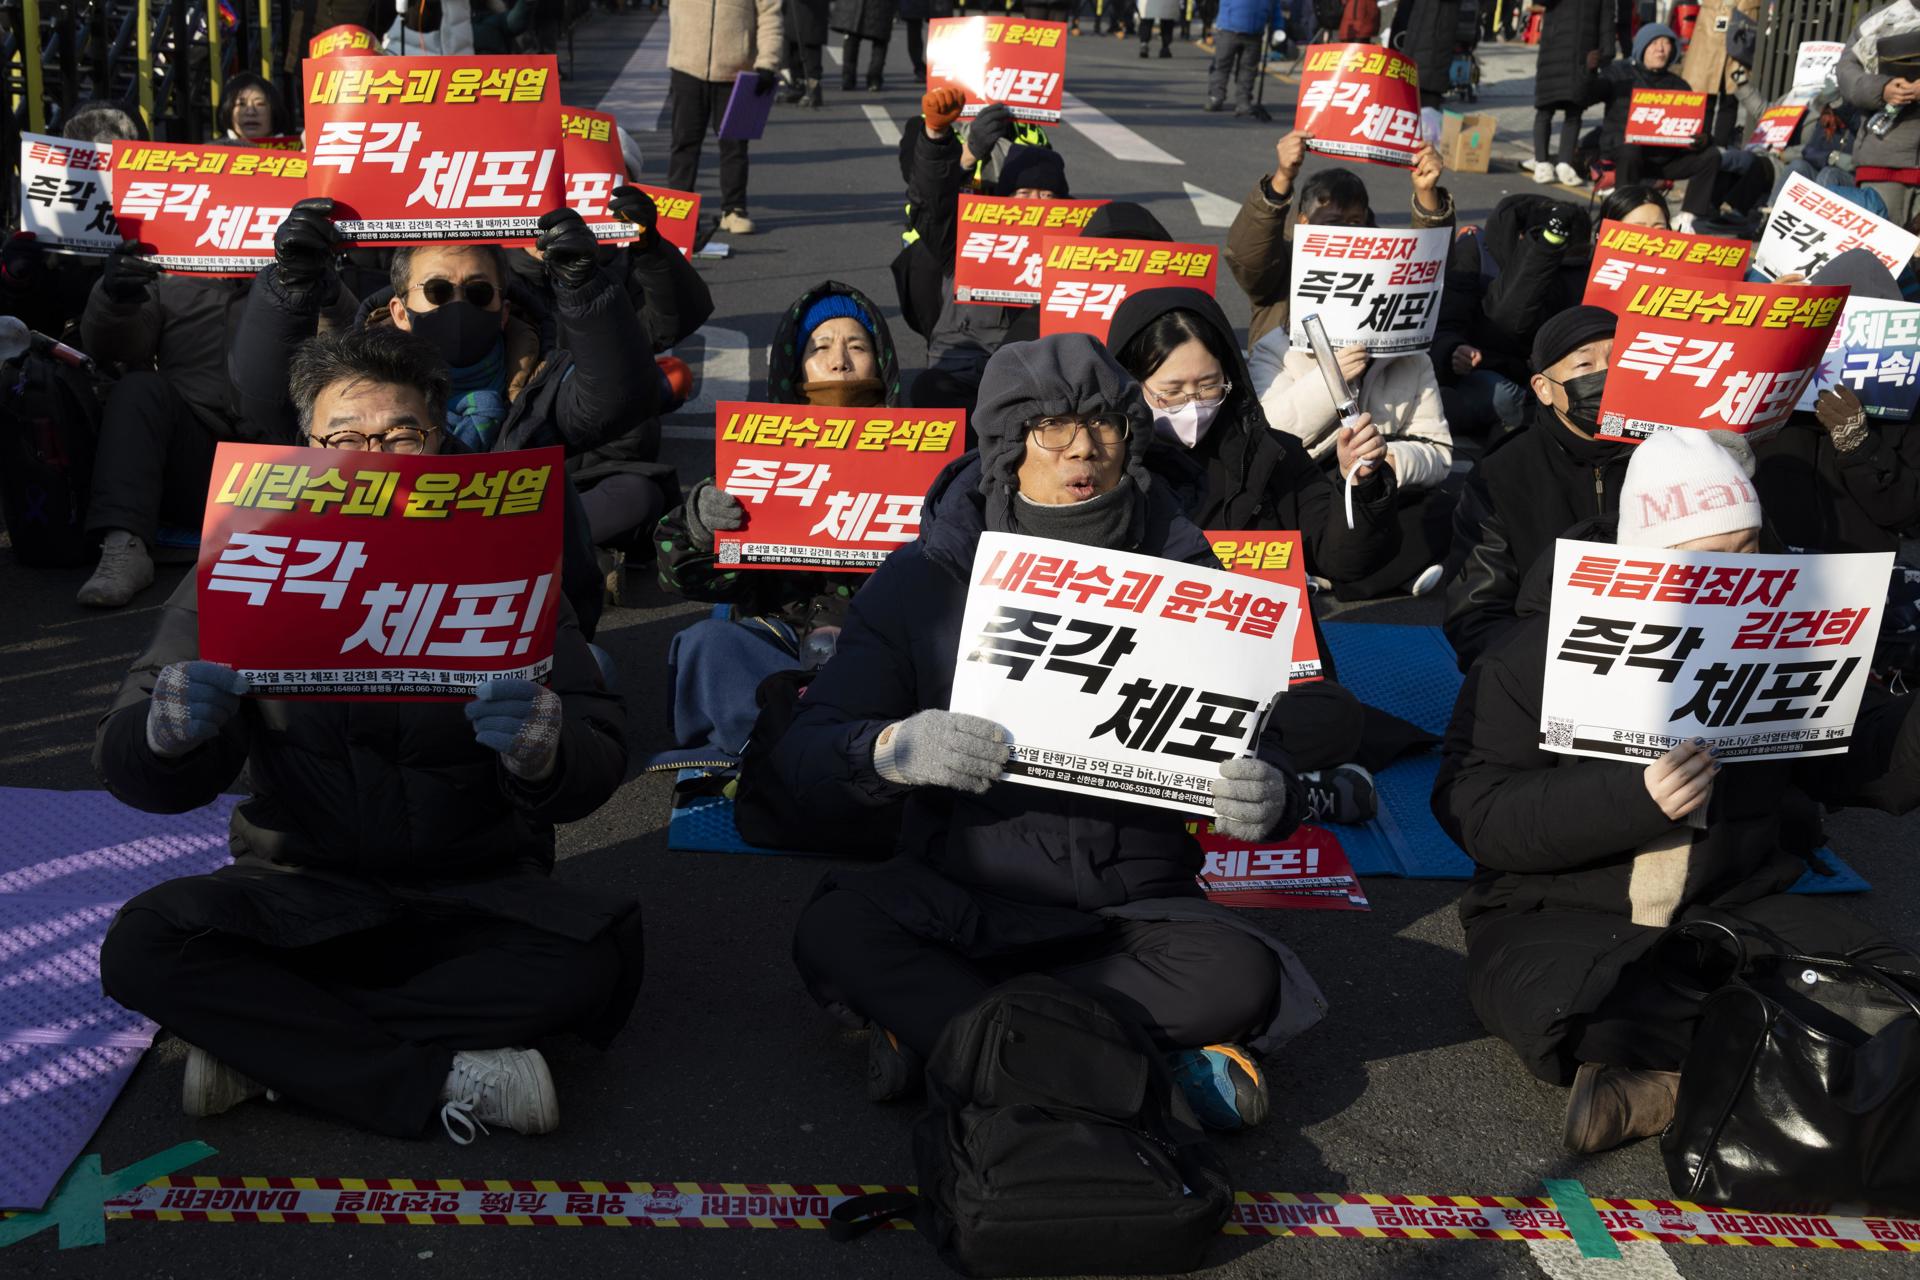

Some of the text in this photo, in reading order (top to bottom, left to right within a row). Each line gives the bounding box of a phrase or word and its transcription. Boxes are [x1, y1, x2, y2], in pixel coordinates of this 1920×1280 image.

[312, 32, 370, 59] 내란수괴
[1004, 24, 1061, 47] 윤석열
[1306, 50, 1387, 75] 내란수괴
[309, 68, 548, 104] 내란수괴 윤석열
[1301, 80, 1371, 115] 즉각
[1631, 107, 1665, 125] 즉각
[1655, 117, 1701, 136] 체포!
[117, 149, 308, 178] 내란수괴 윤석열
[312, 122, 422, 174] 즉각
[27, 175, 97, 212] 즉각
[405, 149, 557, 209] 체포!
[565, 173, 623, 216] 포!
[120, 182, 211, 222] 즉각
[647, 193, 694, 220] 석열
[961, 202, 1045, 226] 내란수괴
[1786, 182, 1879, 238] 특급범죄자
[340, 221, 364, 231] 윤석열
[367, 222, 383, 230] 즉각
[386, 221, 406, 230] 체포!
[408, 220, 432, 230] 김건희
[454, 219, 472, 229] 구속!
[1770, 210, 1828, 253] 즉각
[960, 232, 1030, 266] 즉각
[1046, 245, 1212, 278] 내란수괴 윤석열
[1302, 234, 1418, 260] 특급범죄자
[1601, 229, 1746, 268] 내란수괴 윤석열
[1835, 236, 1900, 270] 김희
[1297, 270, 1374, 306] 즉각
[1388, 260, 1442, 286] 김건희
[1593, 258, 1667, 291] 즉
[1045, 281, 1128, 321] 즉각
[1357, 290, 1438, 332] 체포!
[1626, 284, 1843, 329] 내란수괴 윤석열
[1846, 311, 1920, 349] 체포
[1617, 331, 1735, 388] 즉각
[1843, 351, 1920, 390] 구속!
[722, 413, 957, 452] 내란수괴 윤석열
[214, 461, 552, 519] 내란수괴 윤석열
[724, 459, 832, 507] 즉각
[747, 545, 770, 554] 윤석열
[772, 546, 786, 555] 즉각
[789, 547, 807, 556] 체포!
[809, 548, 832, 558] 김건희
[834, 550, 850, 558] 즉각
[851, 550, 869, 559] 구속!
[1212, 541, 1294, 570] 윤석열
[207, 532, 368, 610] 즉각
[1567, 556, 1799, 608] 특급범죄자
[979, 550, 1289, 640] 내란수괴 윤석열
[339, 572, 553, 657] 체포!
[1731, 607, 1871, 650] 김건희
[967, 606, 1138, 695] 즉각
[1557, 615, 1705, 683] 즉각
[245, 672, 279, 683] 윤석열
[283, 673, 307, 683] 즉각
[311, 672, 338, 682] 체포!
[342, 671, 378, 682] 김건희
[381, 670, 404, 682] 즉각
[408, 671, 435, 682] 구속!
[454, 673, 488, 684] 때까지
[416, 685, 466, 694] 060-707-3300
[1668, 656, 1862, 728] 체포!
[1612, 730, 1646, 745] 윤석열
[1649, 735, 1687, 748] 탄핵기
[1718, 729, 1820, 748] bit.ly/윤석열탄핵기금
[1624, 746, 1652, 756] 탄핵기금
[1008, 746, 1039, 762] 윤석열
[1043, 751, 1088, 771] 탄핵기금
[1090, 760, 1109, 775] 5억
[1111, 763, 1134, 779] 모금
[1027, 766, 1055, 780] 탄핵기금
[1056, 770, 1071, 781] 모금
[1077, 773, 1105, 787] 신한은행
[1106, 780, 1160, 796] 100-036-551308
[1201, 848, 1319, 877] 체포!
[160, 1188, 300, 1212] DANGER!
[336, 1191, 460, 1212] 안전제일
[480, 1192, 547, 1215] 危險
[565, 1193, 626, 1214] 위험
[701, 1196, 829, 1217] DANGER!
[1370, 1206, 1490, 1228] 안전제일
[1708, 1214, 1838, 1237] DANGER!
